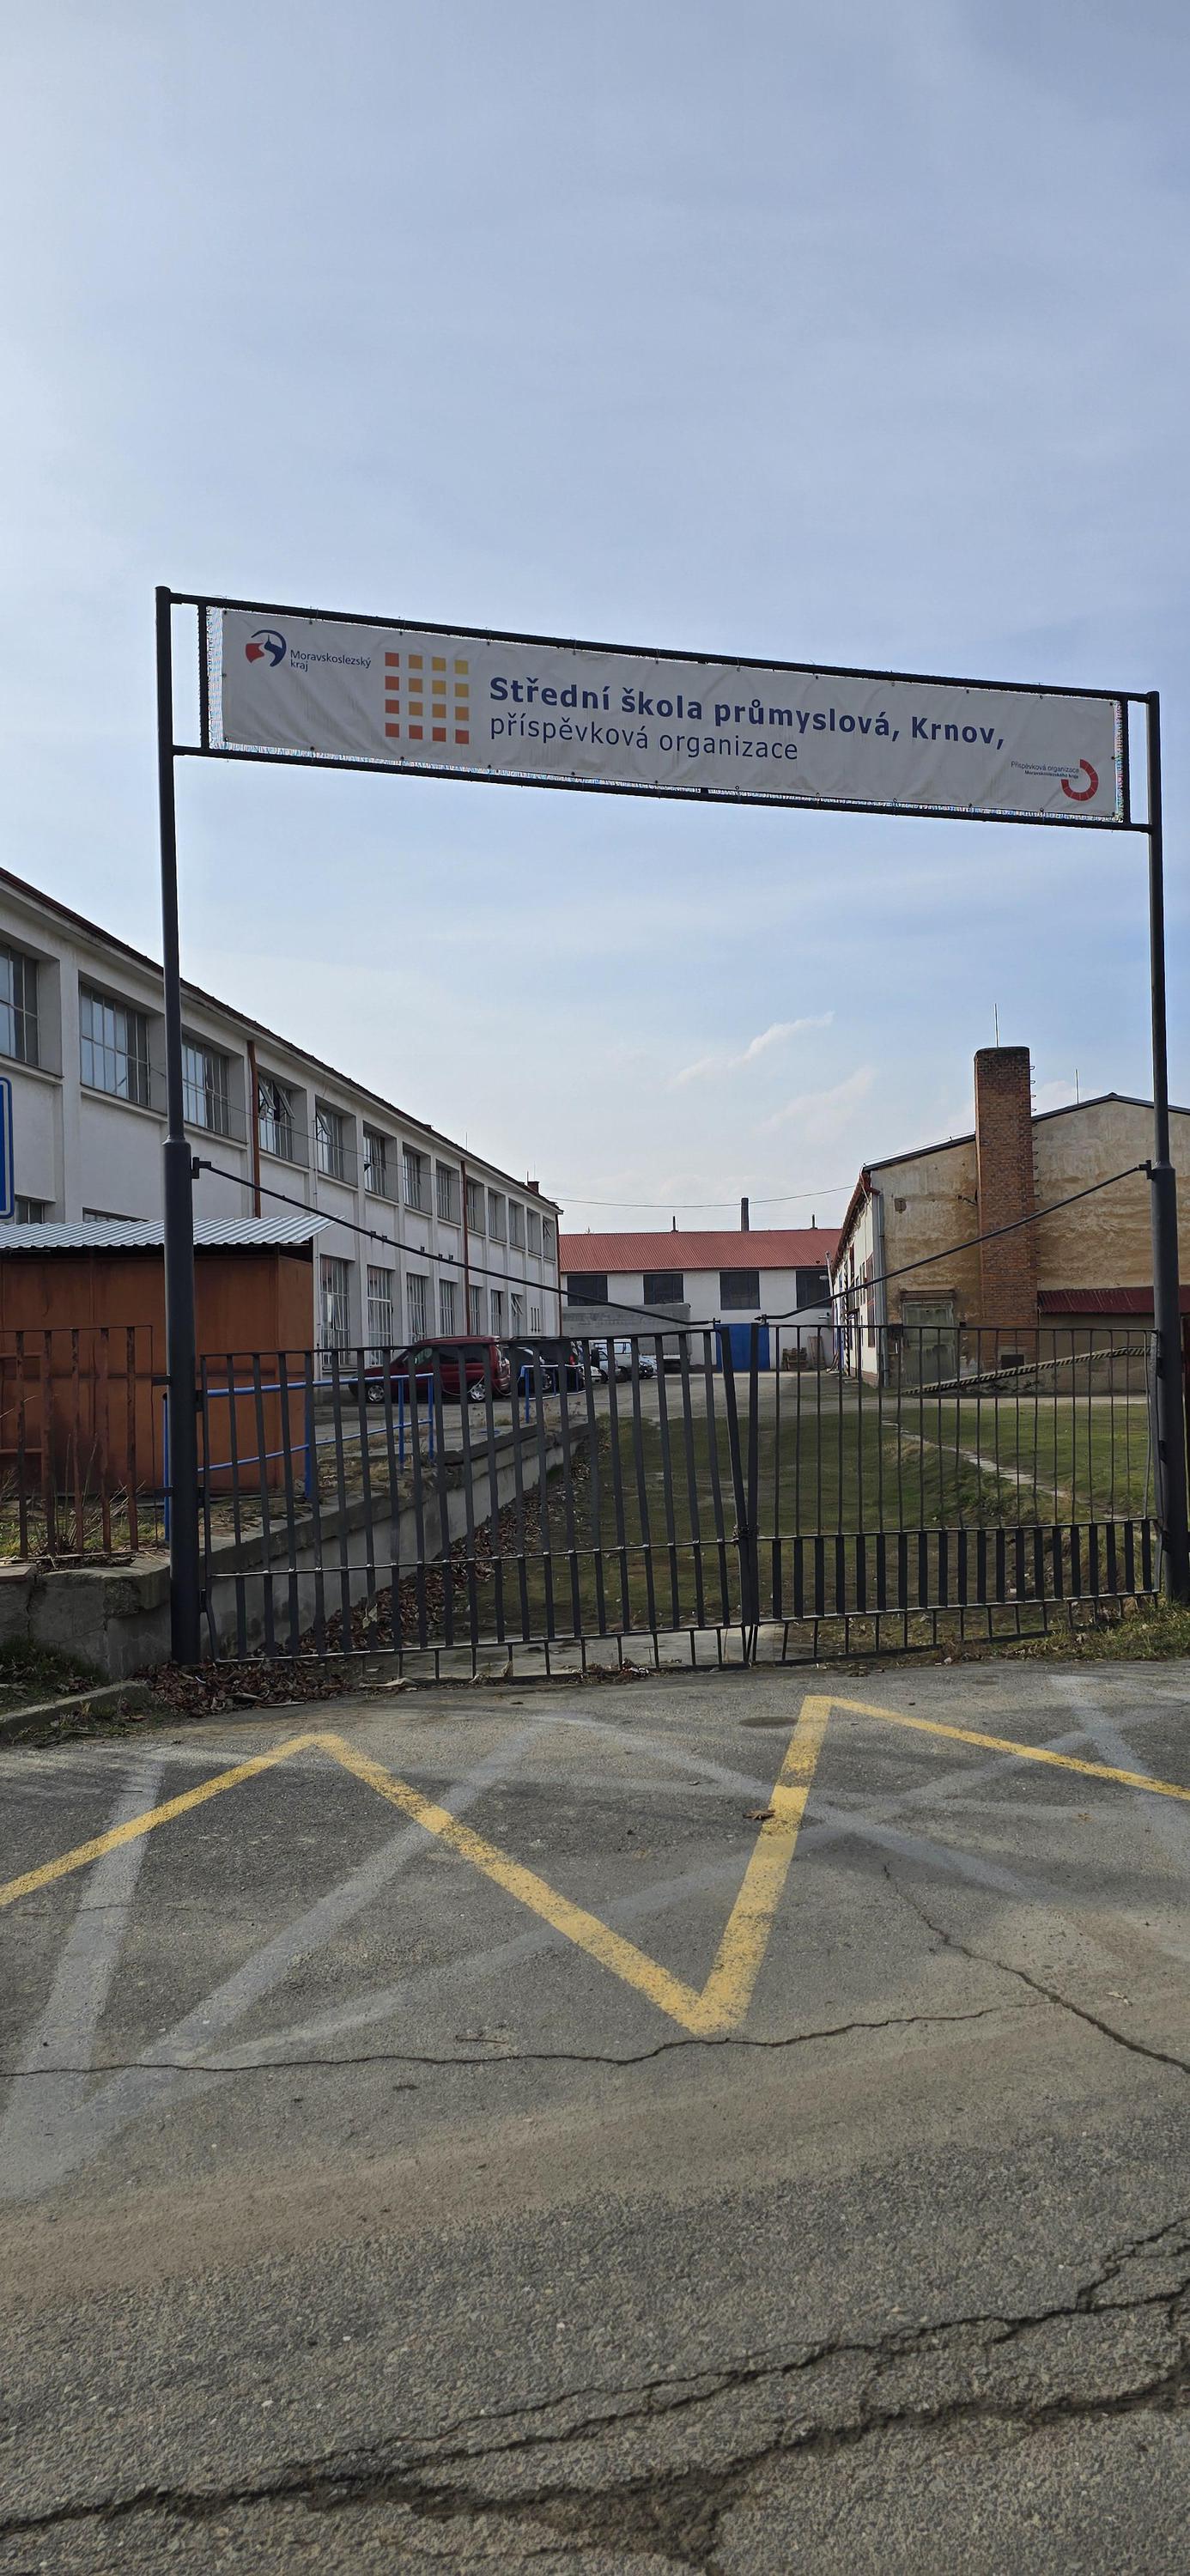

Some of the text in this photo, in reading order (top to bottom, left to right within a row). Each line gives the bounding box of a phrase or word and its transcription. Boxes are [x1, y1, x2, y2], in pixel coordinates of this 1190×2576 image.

[291, 649, 372, 668] Moravskoslezský
[291, 659, 308, 671] kraj
[489, 677, 1005, 750] Střední škola průmyslová, Krnov,
[490, 712, 798, 760] příspěvková organizace
[1047, 764, 1079, 774] organizace
